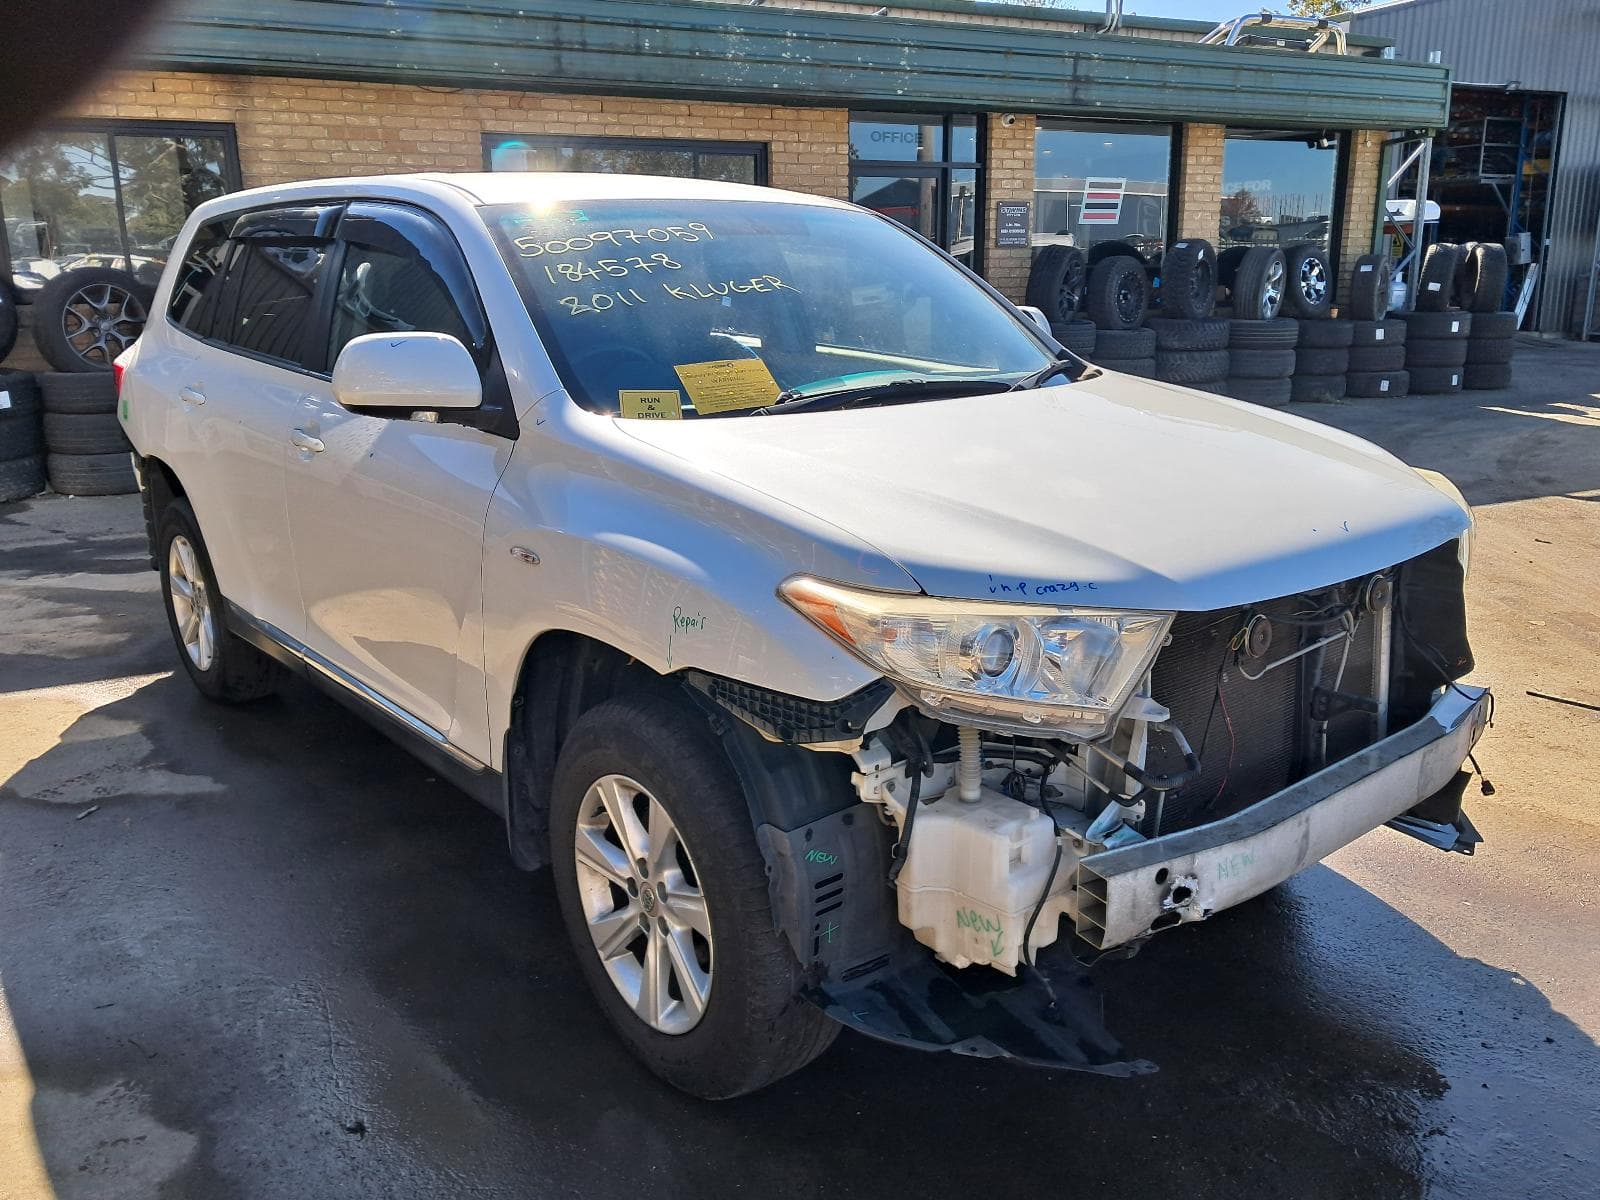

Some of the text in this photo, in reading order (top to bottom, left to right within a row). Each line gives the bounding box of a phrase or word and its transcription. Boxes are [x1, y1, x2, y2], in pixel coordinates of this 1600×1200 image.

[871, 130, 923, 144] OFFICE
[513, 222, 714, 257] 50097059
[544, 253, 682, 284] 184578
[559, 275, 801, 316] 2011 KLUGER
[637, 411, 666, 419] DRIVE
[673, 606, 706, 634] Repair
